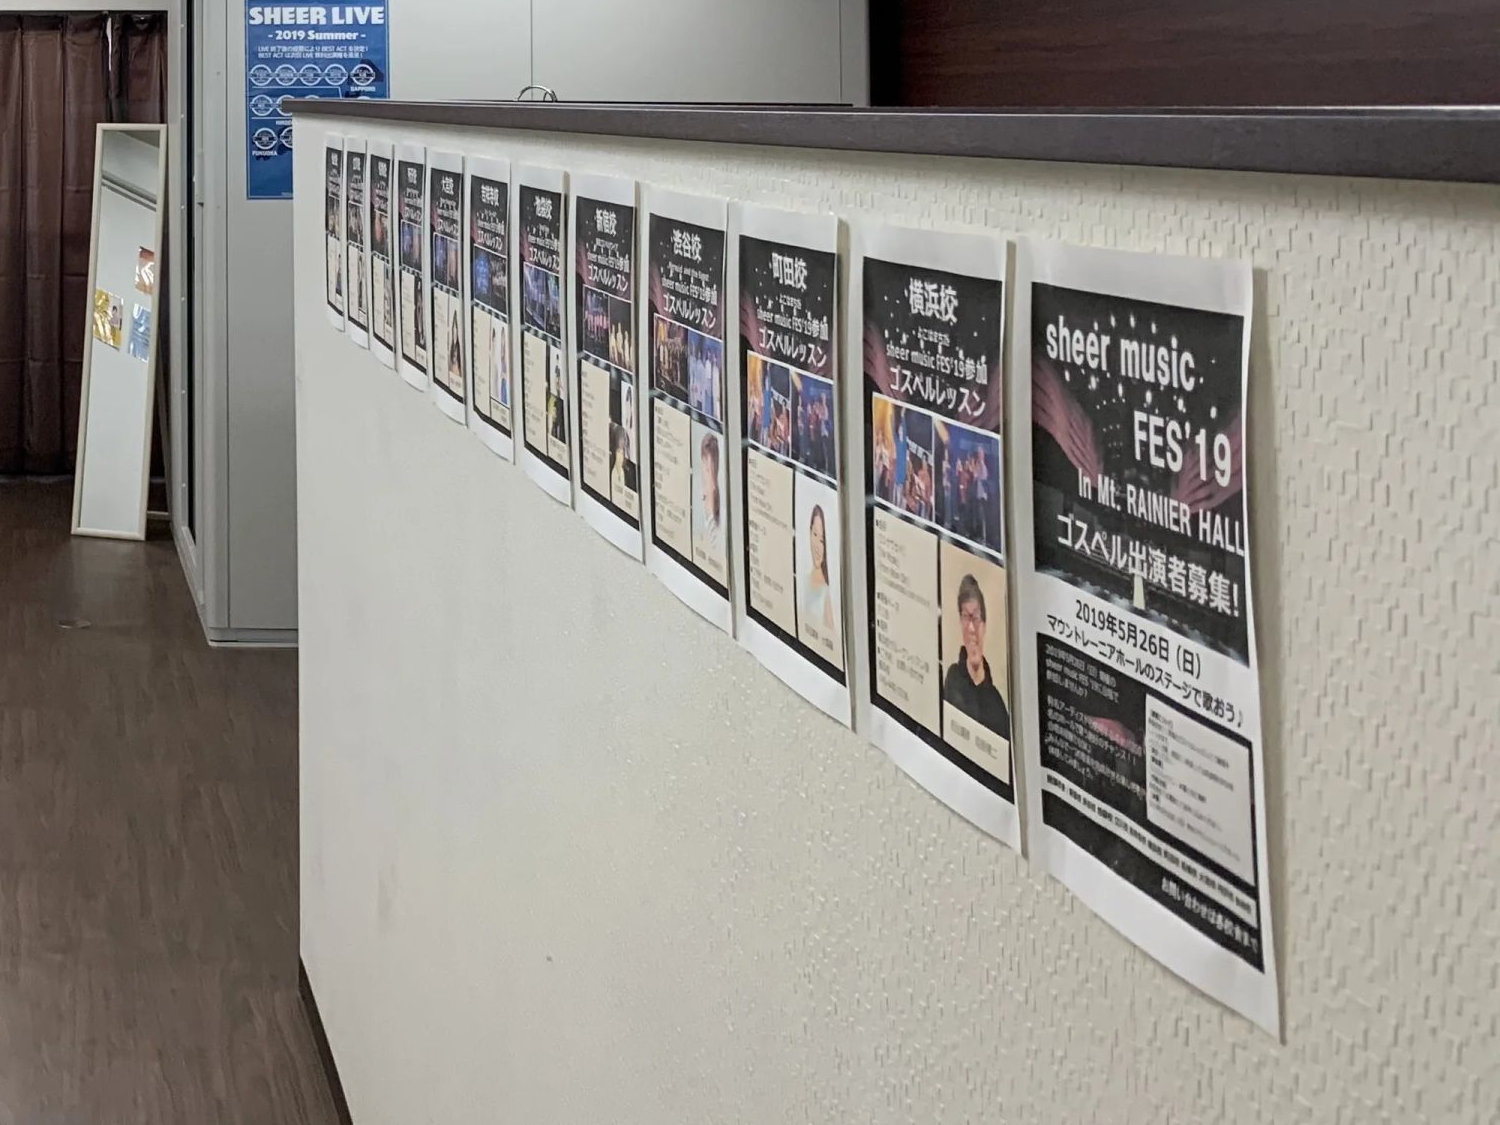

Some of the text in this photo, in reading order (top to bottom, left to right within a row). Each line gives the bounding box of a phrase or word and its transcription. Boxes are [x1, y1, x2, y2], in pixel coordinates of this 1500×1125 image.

[249, 6, 385, 25] SHEER LIVE
[275, 30, 359, 40] 2019 Summer
[672, 228, 702, 262] 渋谷校
[771, 252, 808, 291] 町田校
[909, 277, 958, 323] 横浜校
[759, 326, 827, 368] ゴスペルレッスン
[886, 340, 910, 361] sheer
[910, 350, 935, 369] music
[1046, 315, 1195, 392] sheer music
[890, 365, 986, 417] ゴスペルレッスン
[1134, 410, 1232, 487] FES'19
[1097, 474, 1122, 511] Mt.
[1126, 483, 1192, 537] RAINIER
[1199, 508, 1245, 557] HALL
